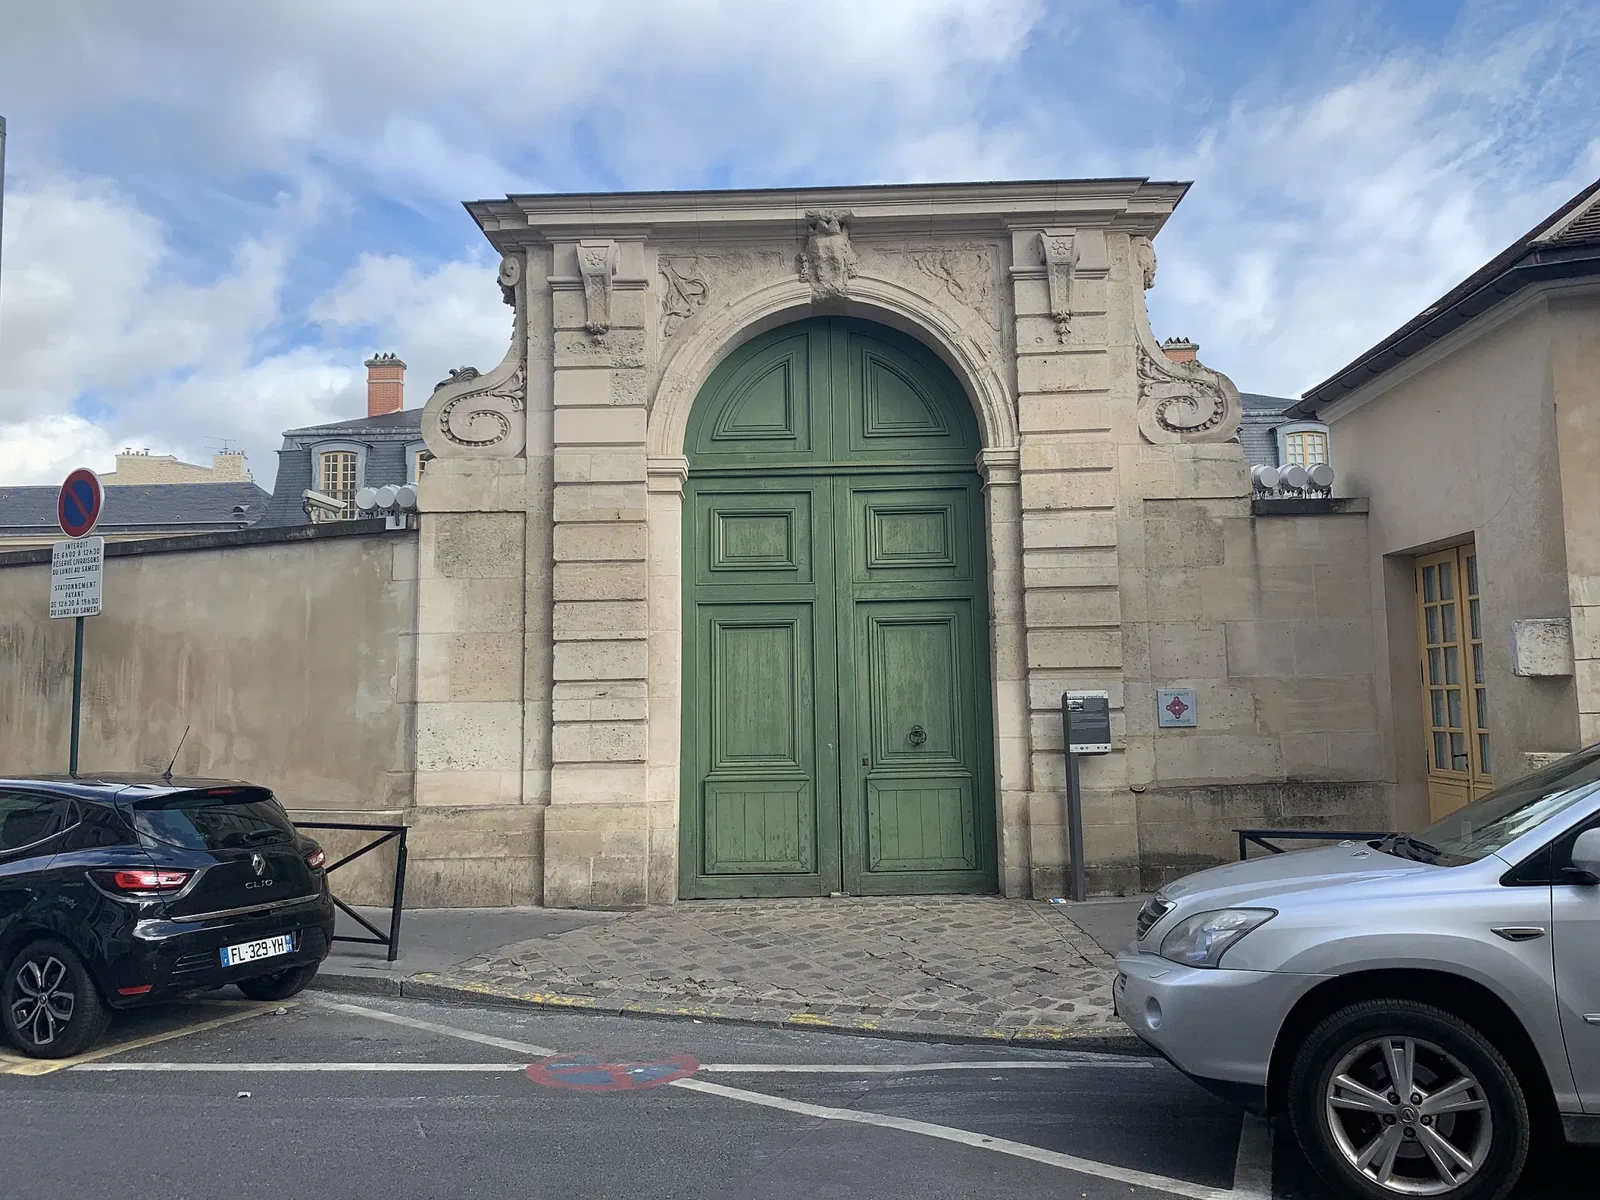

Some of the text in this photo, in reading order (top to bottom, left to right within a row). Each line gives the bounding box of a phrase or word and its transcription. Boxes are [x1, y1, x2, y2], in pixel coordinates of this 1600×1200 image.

[65, 541, 88, 550] INTERDIT
[83, 547, 100, 556] 12h30
[73, 556, 100, 566] LIVRAISONS
[59, 567, 73, 575] LUNDI
[74, 566, 80, 574] AU
[81, 565, 99, 573] SAMEDI
[54, 581, 96, 592] STATIONNEMENT
[65, 590, 84, 599] PAYANT
[58, 599, 75, 608] 12h30
[57, 608, 72, 616] LUNDI
[73, 607, 80, 615] AU
[80, 606, 99, 614] SAMEDI
[245, 880, 273, 889] CLIO
[231, 938, 284, 963] FL-329-YH
